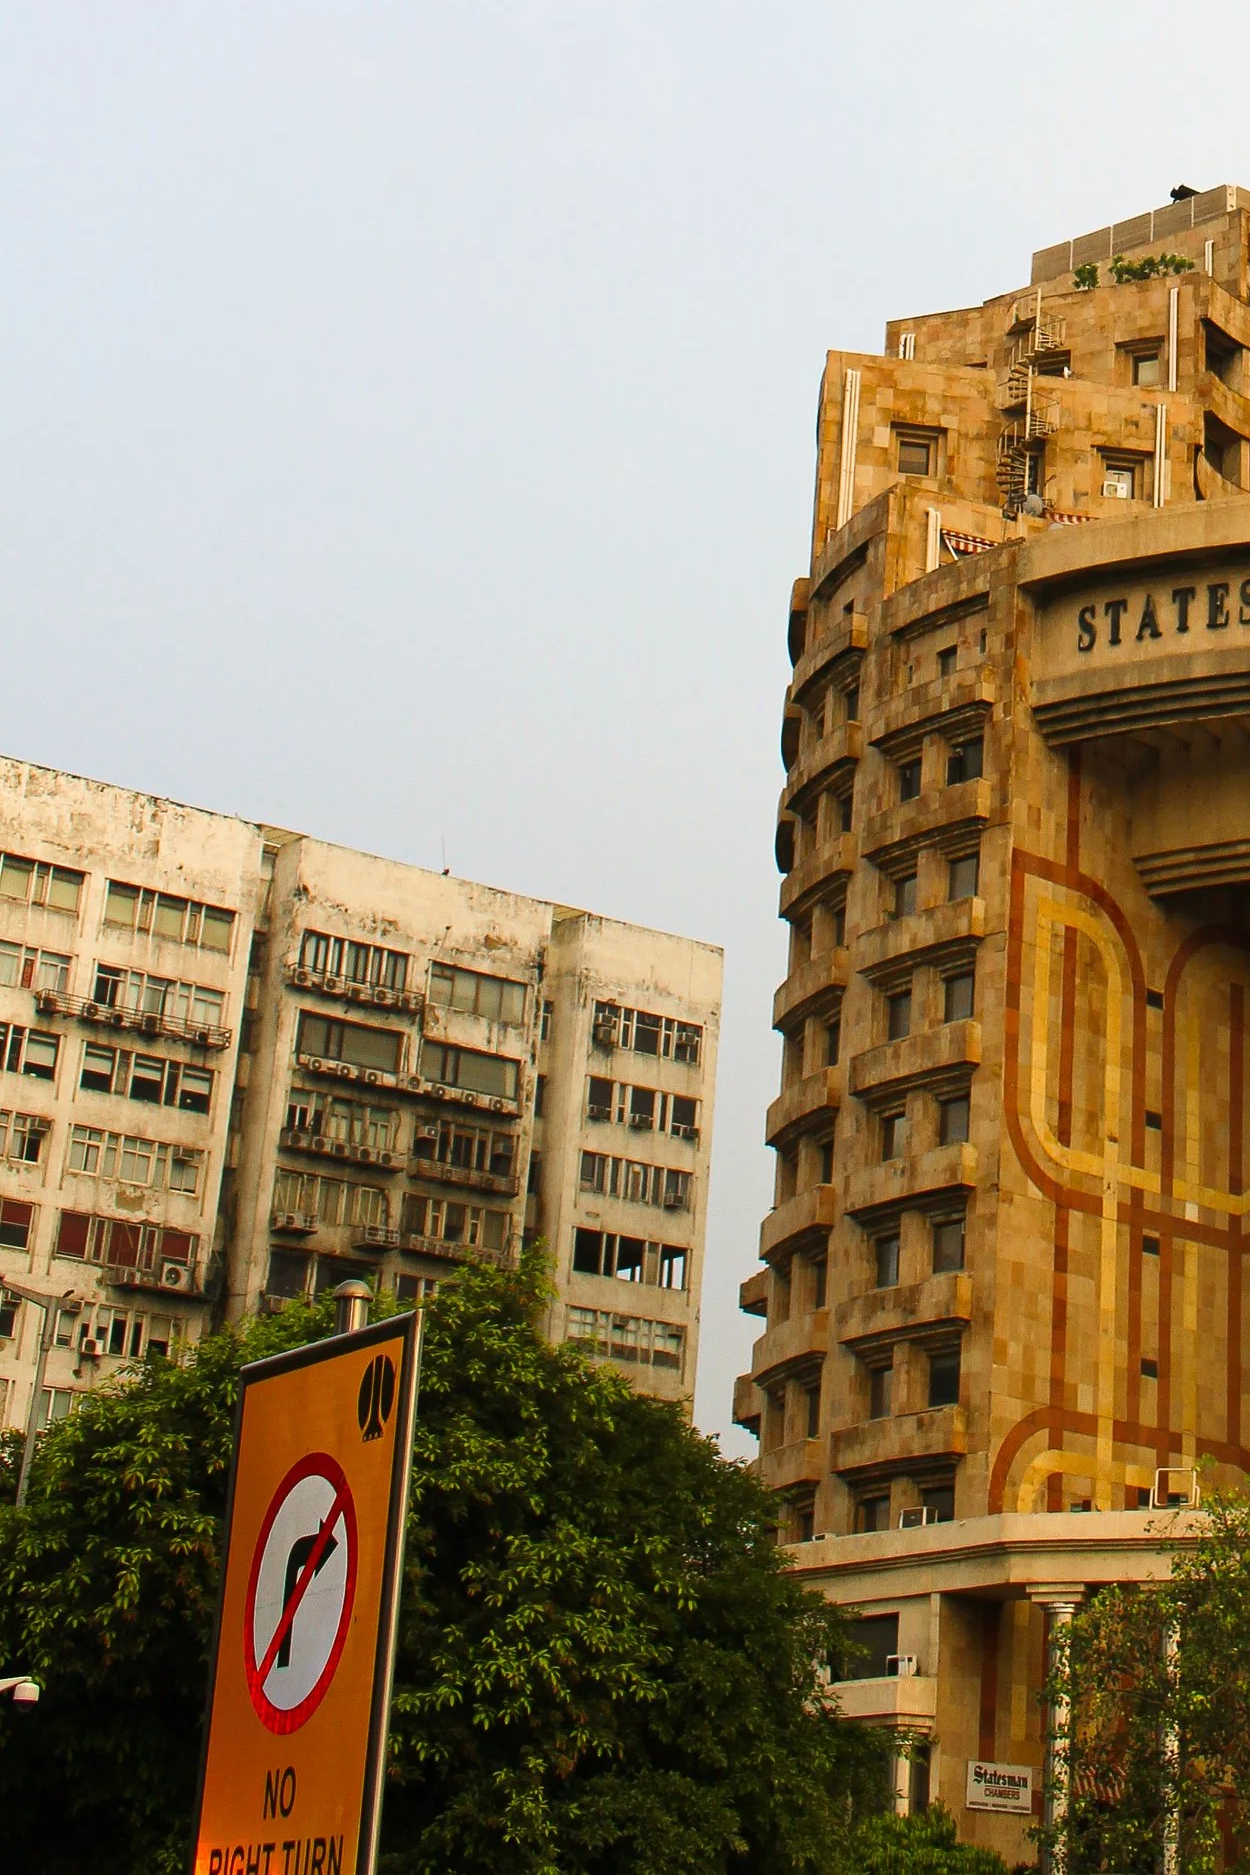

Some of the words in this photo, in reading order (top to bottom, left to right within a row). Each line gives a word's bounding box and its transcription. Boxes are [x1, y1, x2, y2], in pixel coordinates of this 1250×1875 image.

[263, 1766, 296, 1820] NO
[973, 1765, 1028, 1789] Statesman
[208, 1842, 276, 1875] RIGHT
[283, 1834, 343, 1875] TURN
